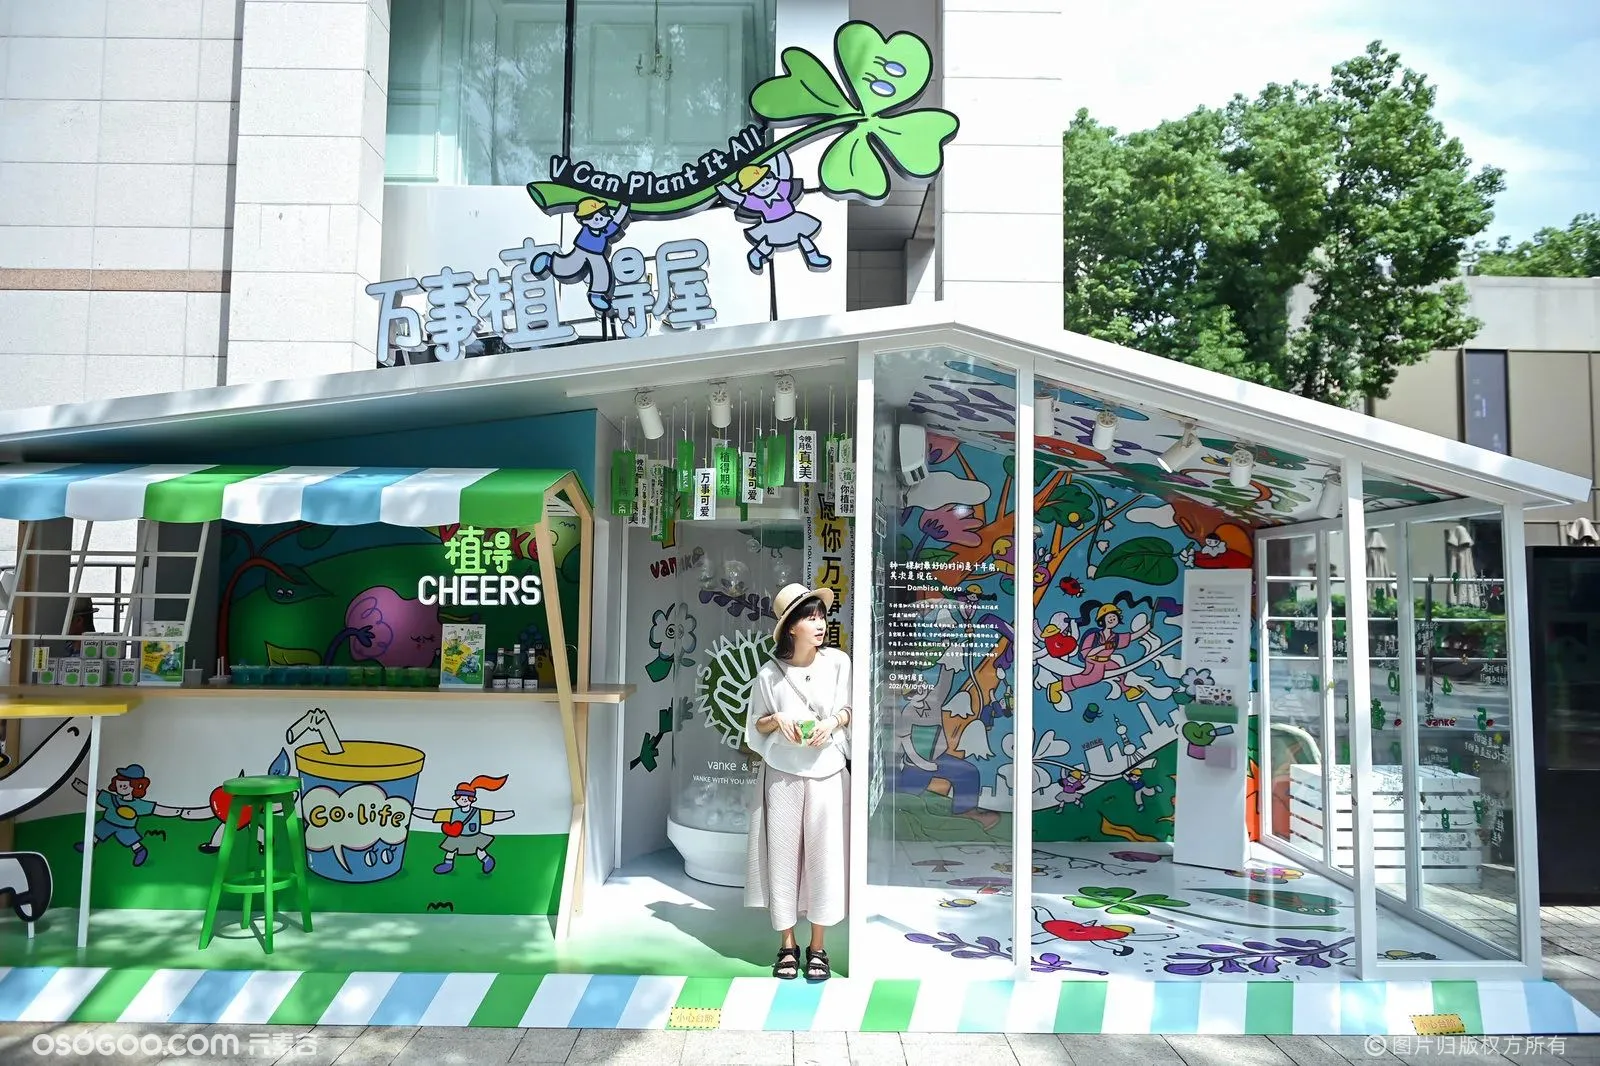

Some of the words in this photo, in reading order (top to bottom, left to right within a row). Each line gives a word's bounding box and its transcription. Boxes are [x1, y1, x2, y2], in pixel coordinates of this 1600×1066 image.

[553, 158, 568, 178] V
[573, 164, 620, 193] Can
[629, 164, 699, 195] Plant
[701, 152, 728, 179] It
[731, 127, 762, 161] All
[700, 472, 710, 517] 万事可爱
[747, 456, 757, 501] 万事可爱
[445, 525, 512, 574] 植得
[418, 575, 541, 606] CHEERS
[692, 774, 711, 783] VANKE
[730, 777, 745, 785] YOU
[707, 760, 737, 771] vanke
[741, 762, 749, 771] &
